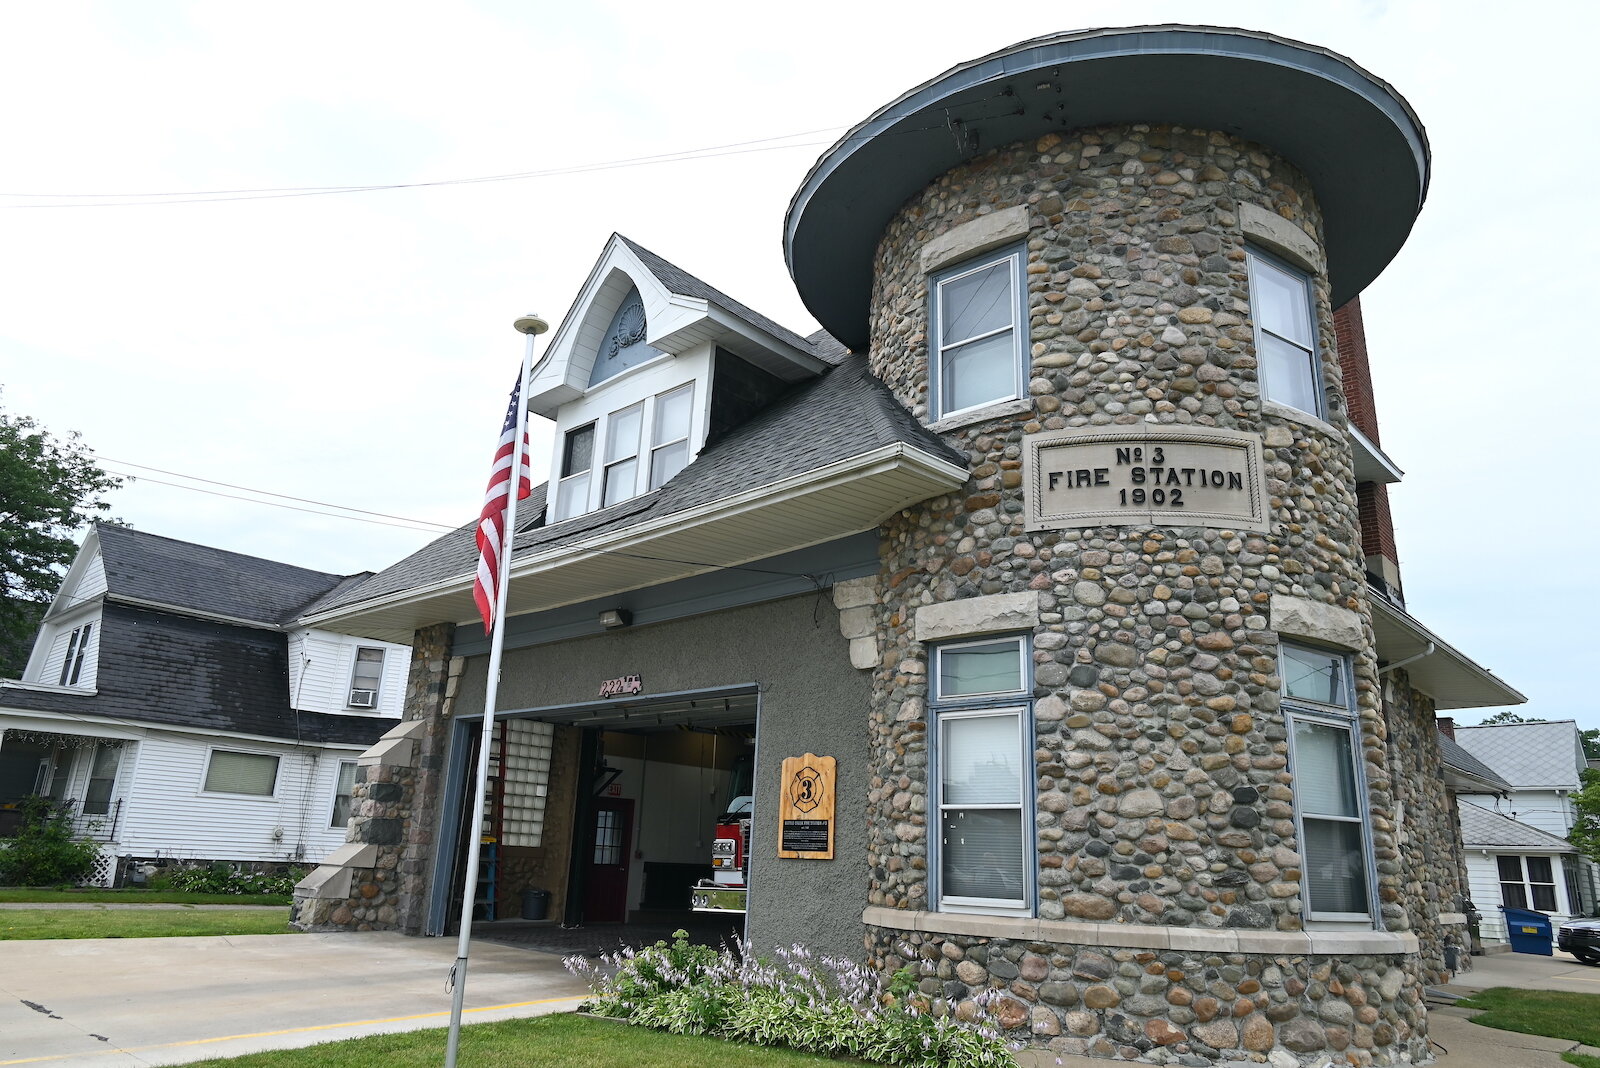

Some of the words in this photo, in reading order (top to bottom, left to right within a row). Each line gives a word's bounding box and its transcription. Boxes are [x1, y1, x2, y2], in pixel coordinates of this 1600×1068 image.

[1152, 447, 1165, 464] 3
[1048, 468, 1110, 490] FIRE
[1131, 467, 1243, 490] STATION
[1119, 488, 1184, 507] 1902
[801, 780, 812, 800] 3
